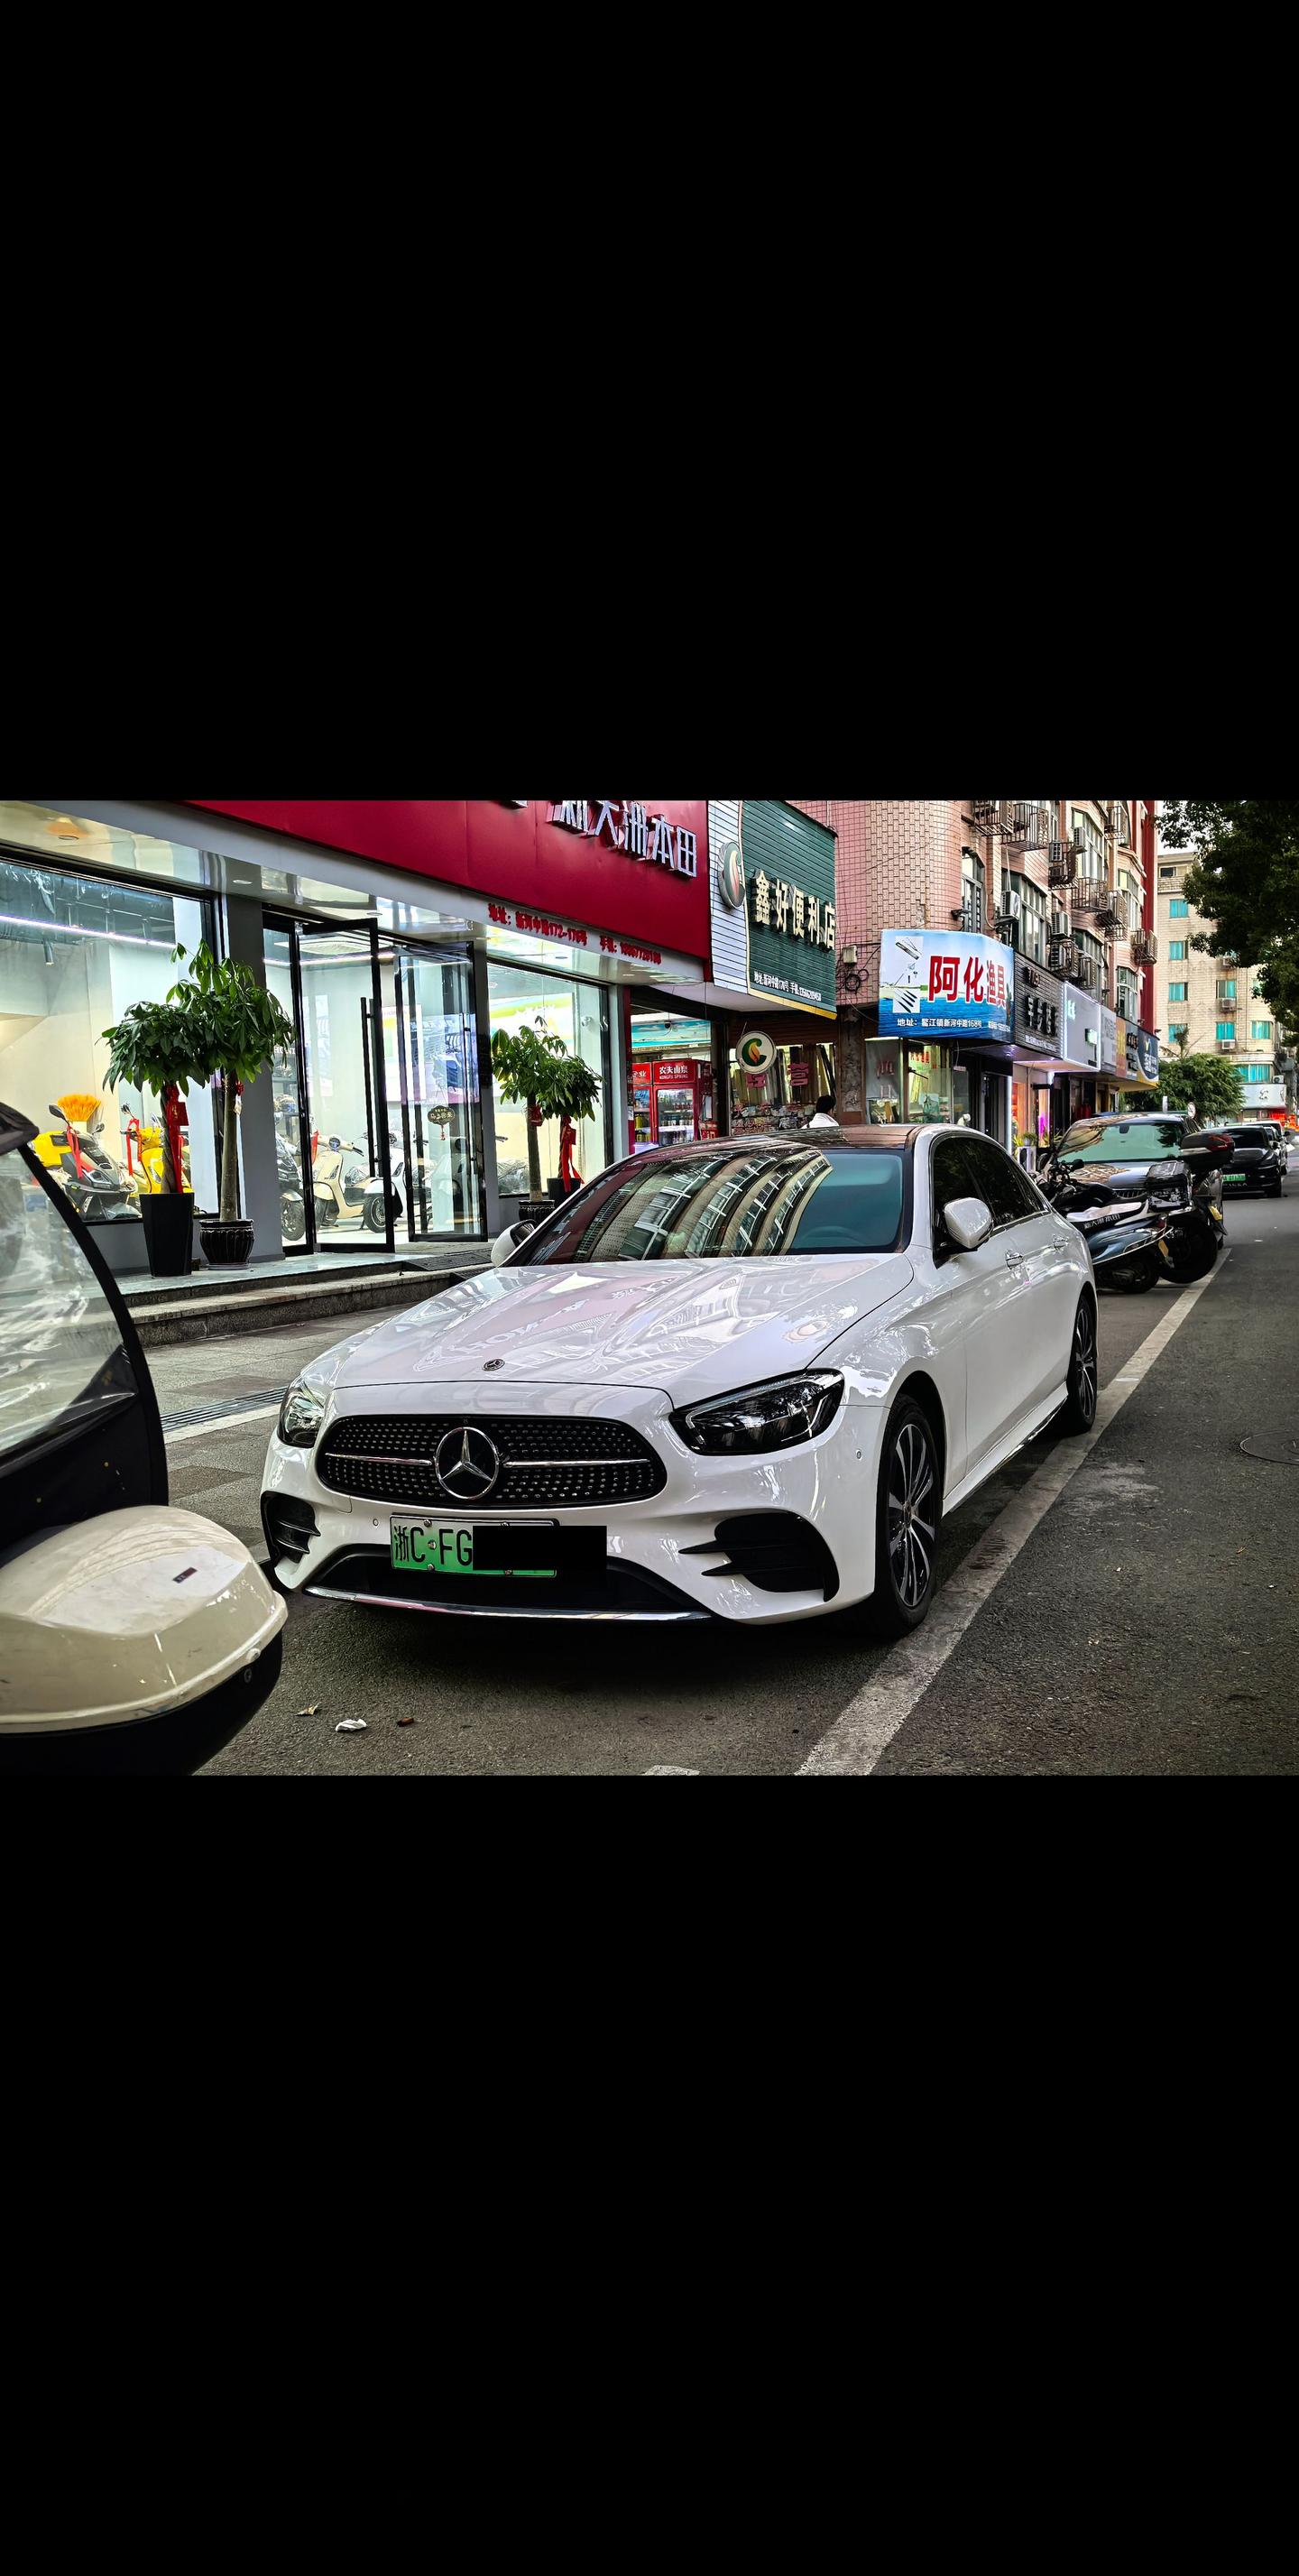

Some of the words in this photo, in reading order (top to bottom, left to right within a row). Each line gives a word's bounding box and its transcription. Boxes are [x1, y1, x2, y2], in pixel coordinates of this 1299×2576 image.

[756, 870, 835, 949] 鑫好便利店
[928, 955, 1005, 1008] 阿化渔具
[659, 1066, 688, 1075] 农夫山泉
